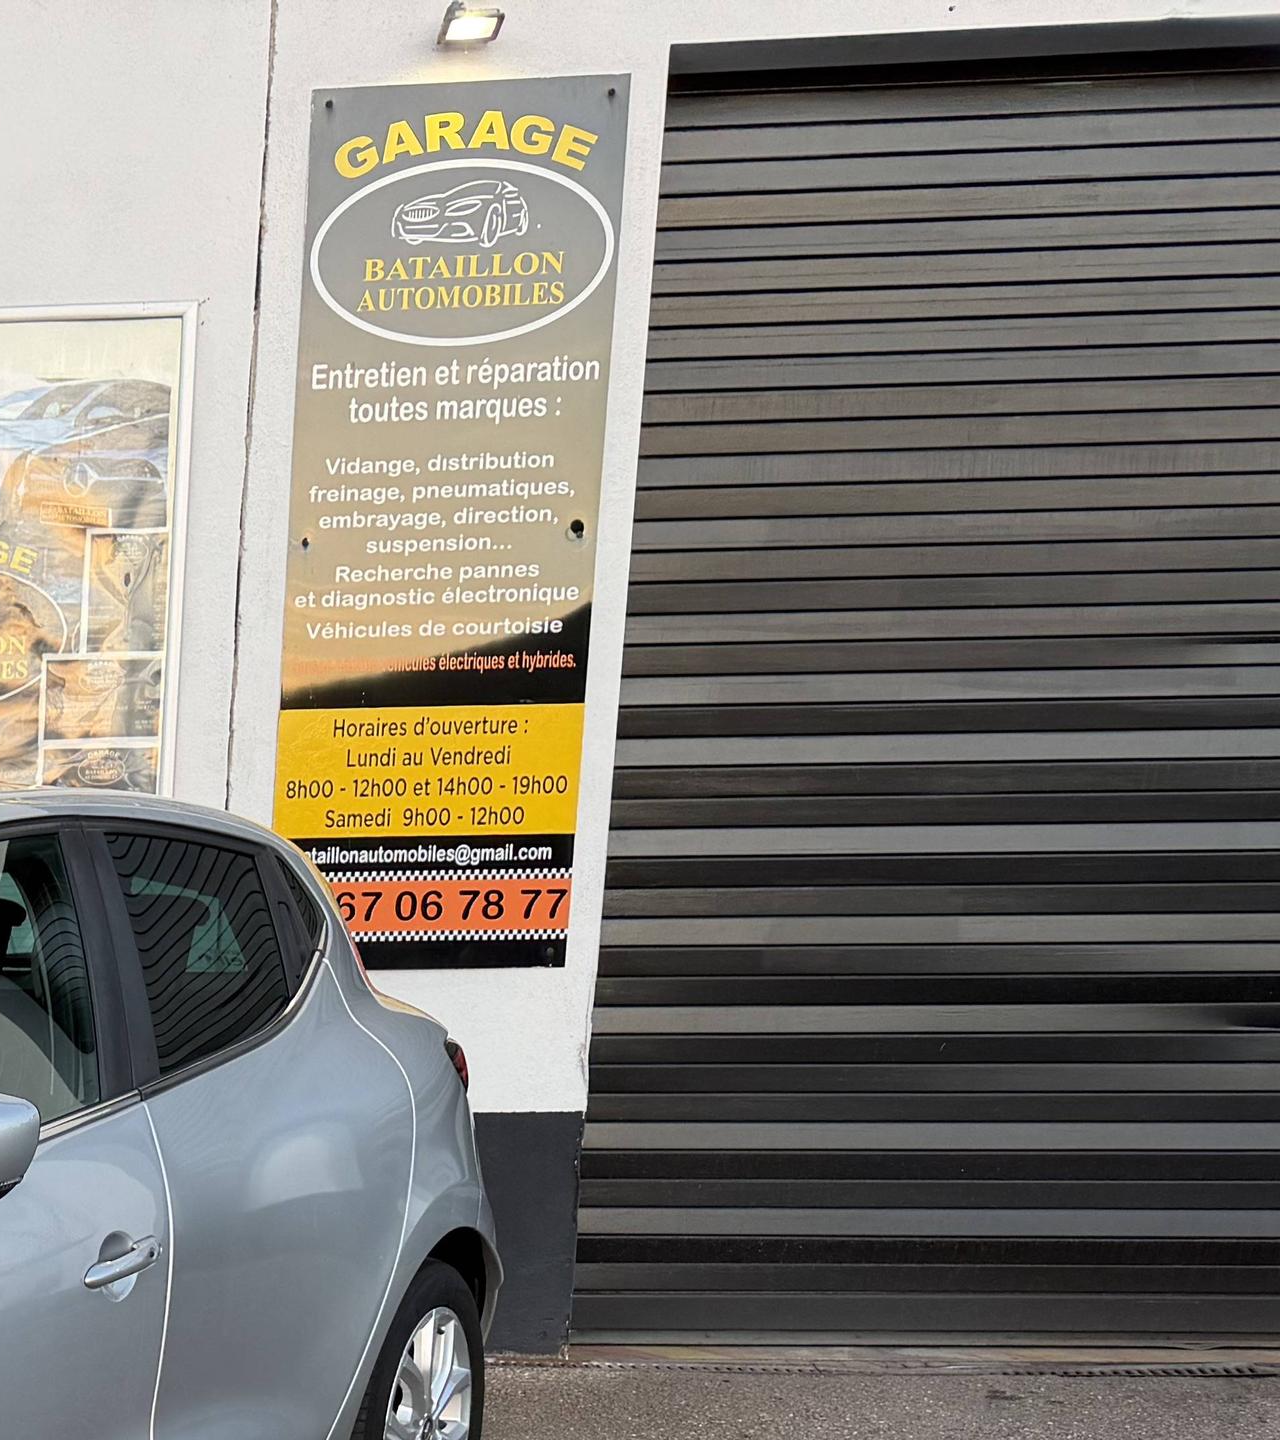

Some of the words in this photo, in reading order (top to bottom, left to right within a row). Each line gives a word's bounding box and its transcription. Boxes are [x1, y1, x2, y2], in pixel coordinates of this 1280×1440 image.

[334, 110, 598, 179] GARAGE
[362, 251, 565, 282] BATAILLON
[356, 281, 565, 313] AUTOMOBILES
[311, 361, 428, 391] Entretien
[434, 363, 460, 386] et
[466, 355, 601, 389] réparation
[348, 396, 429, 424] toutes
[435, 395, 548, 425] marques
[325, 454, 421, 478] Vidange,
[427, 451, 555, 473] distribution
[308, 483, 407, 505] freinage,
[411, 478, 576, 504] pneumatiques,
[318, 509, 447, 531] embrayage,
[453, 505, 559, 527] direction,
[366, 533, 513, 557] suspension...
[335, 562, 453, 584] Recherche
[458, 563, 540, 585] pannes
[294, 590, 316, 609] et
[321, 587, 435, 611] diagnostic
[441, 584, 580, 608] électronique
[305, 619, 413, 640] Véhicules
[418, 619, 446, 637] de
[452, 616, 564, 636] courtoisie
[438, 652, 506, 674] électriques
[507, 651, 521, 669] et
[521, 650, 577, 672] hybrides.
[332, 718, 408, 738] Horaires
[346, 747, 397, 768] Lundi
[402, 750, 424, 767] au
[431, 744, 512, 766] Vendredi
[285, 778, 334, 800] 8h00
[352, 777, 407, 798] 12h00
[413, 778, 431, 797] et
[437, 775, 494, 796] 14h00
[512, 774, 568, 795] 19h00
[324, 807, 392, 829] Samedi
[402, 807, 451, 827] 9h00
[470, 806, 525, 825] 12h00
[336, 890, 383, 922] 67
[394, 889, 444, 922] 06
[458, 888, 505, 921] 78
[520, 888, 569, 920] 77
